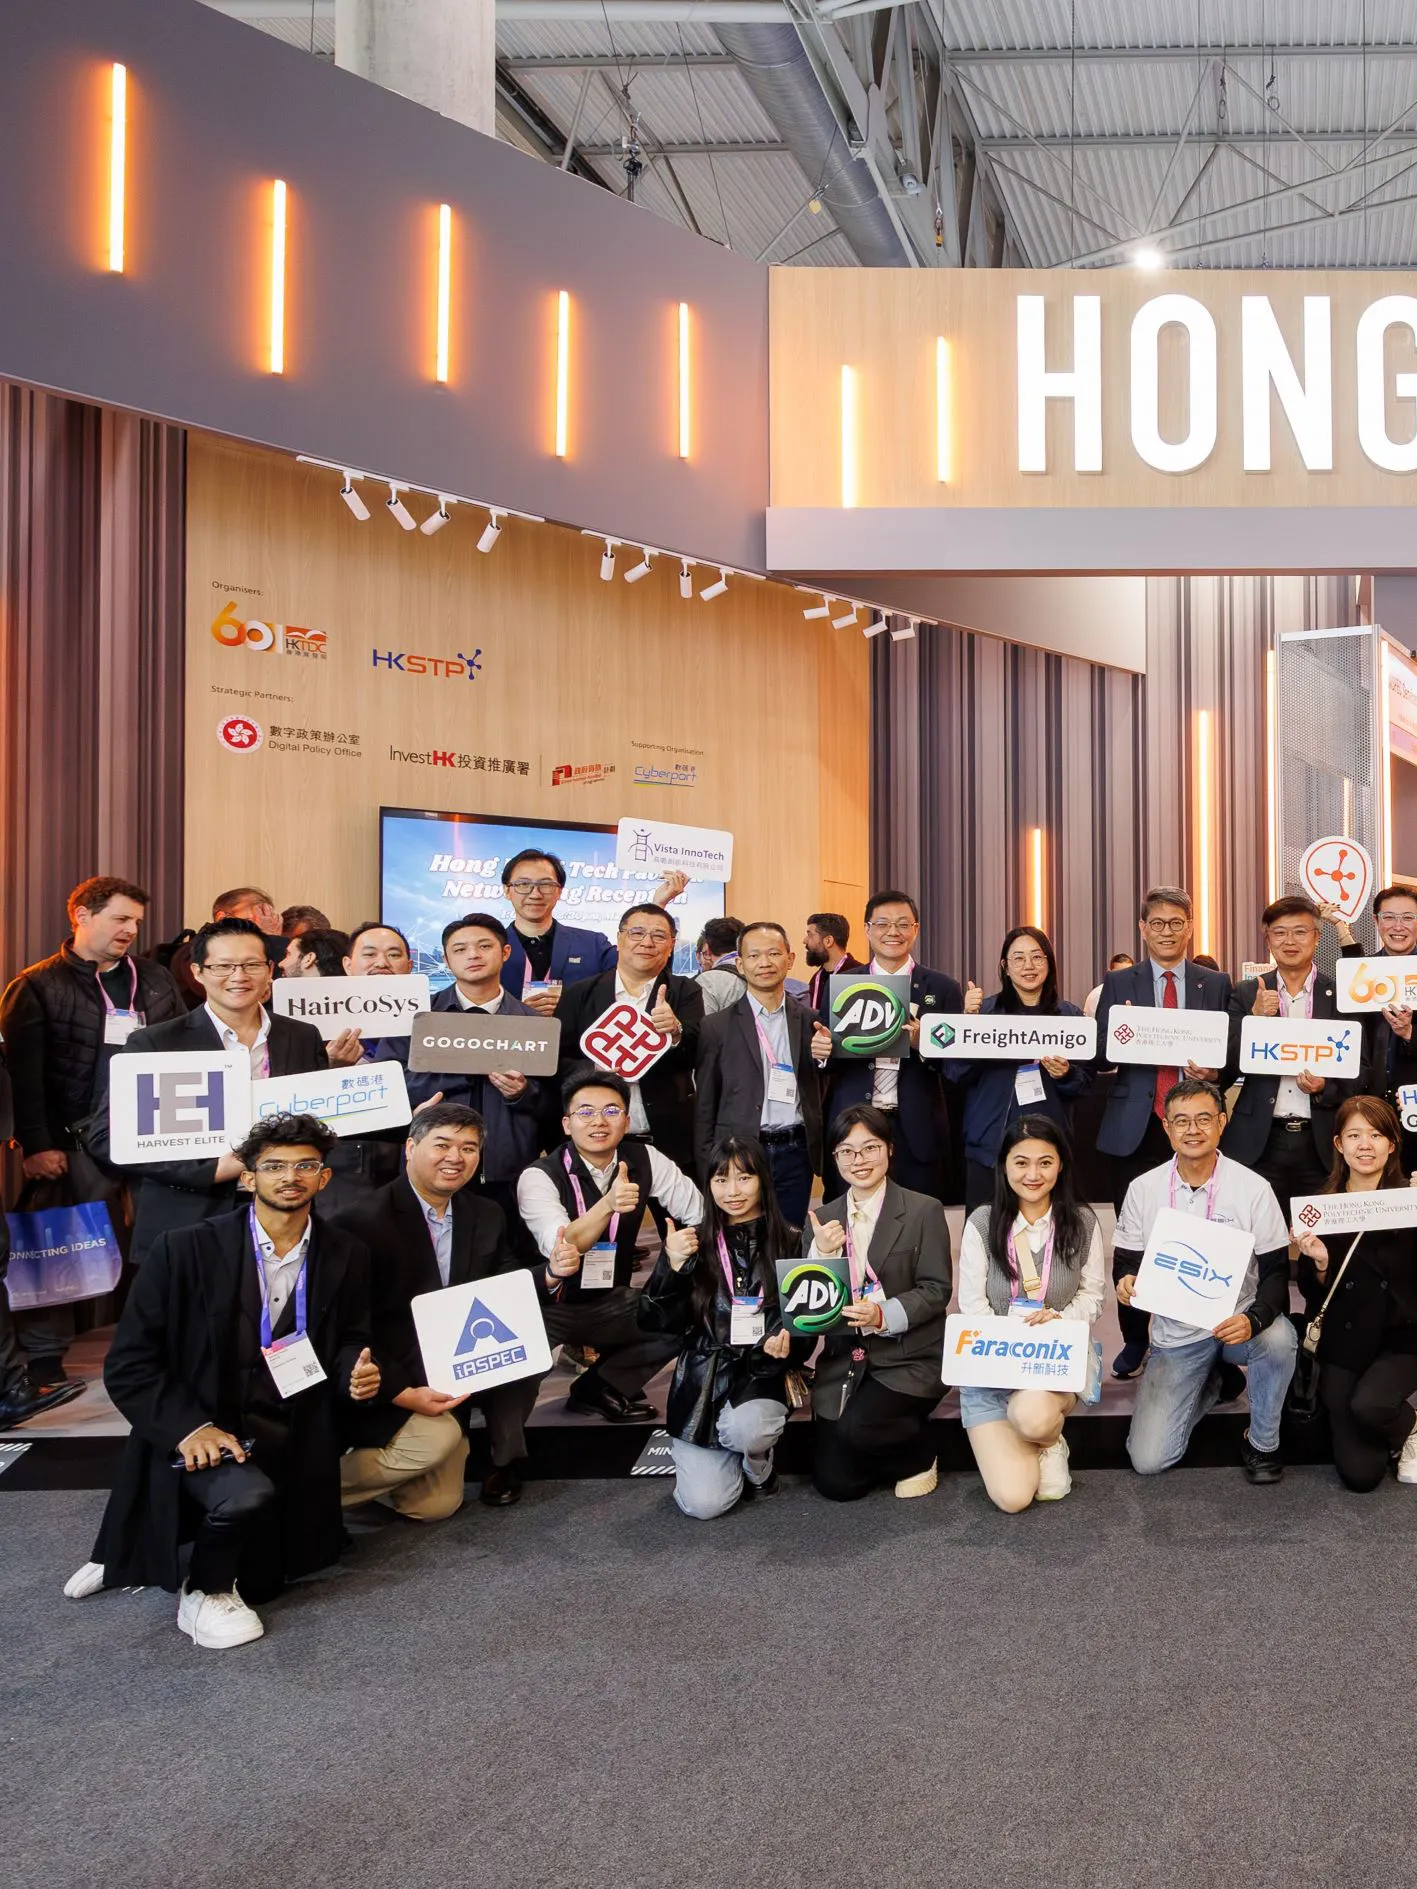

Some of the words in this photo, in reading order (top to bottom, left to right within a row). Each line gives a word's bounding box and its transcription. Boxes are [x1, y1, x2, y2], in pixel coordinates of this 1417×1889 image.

[211, 581, 265, 597] Organisers:
[372, 649, 465, 678] HKSTP
[211, 685, 253, 699] Strategic
[268, 740, 300, 753] Digital
[302, 742, 332, 756] Policy
[334, 747, 362, 758] Office
[389, 745, 456, 767] InvestHK
[634, 766, 697, 785] Cyberport
[654, 843, 679, 855] Vista
[681, 847, 725, 861] InnoTech
[429, 853, 500, 878] Hong
[567, 860, 620, 880] Tech
[585, 885, 688, 906] Receptn
[288, 993, 420, 1018] HairCoSys
[422, 1035, 548, 1053] GOGOCHART
[962, 1028, 1087, 1049] FreightAmigo
[1250, 1042, 1334, 1063] HKSTP
[341, 1073, 385, 1090] 數碼港
[259, 1084, 389, 1120] Cyberport
[137, 1138, 191, 1149] HARVEST
[194, 1135, 225, 1145] ELITE
[71, 1238, 107, 1252] IDEAS
[955, 1329, 1074, 1361] Faraconix
[455, 1347, 524, 1379] iASPEC
[1020, 1362, 1069, 1377] 升新科技
[646, 1446, 672, 1456] MIN
